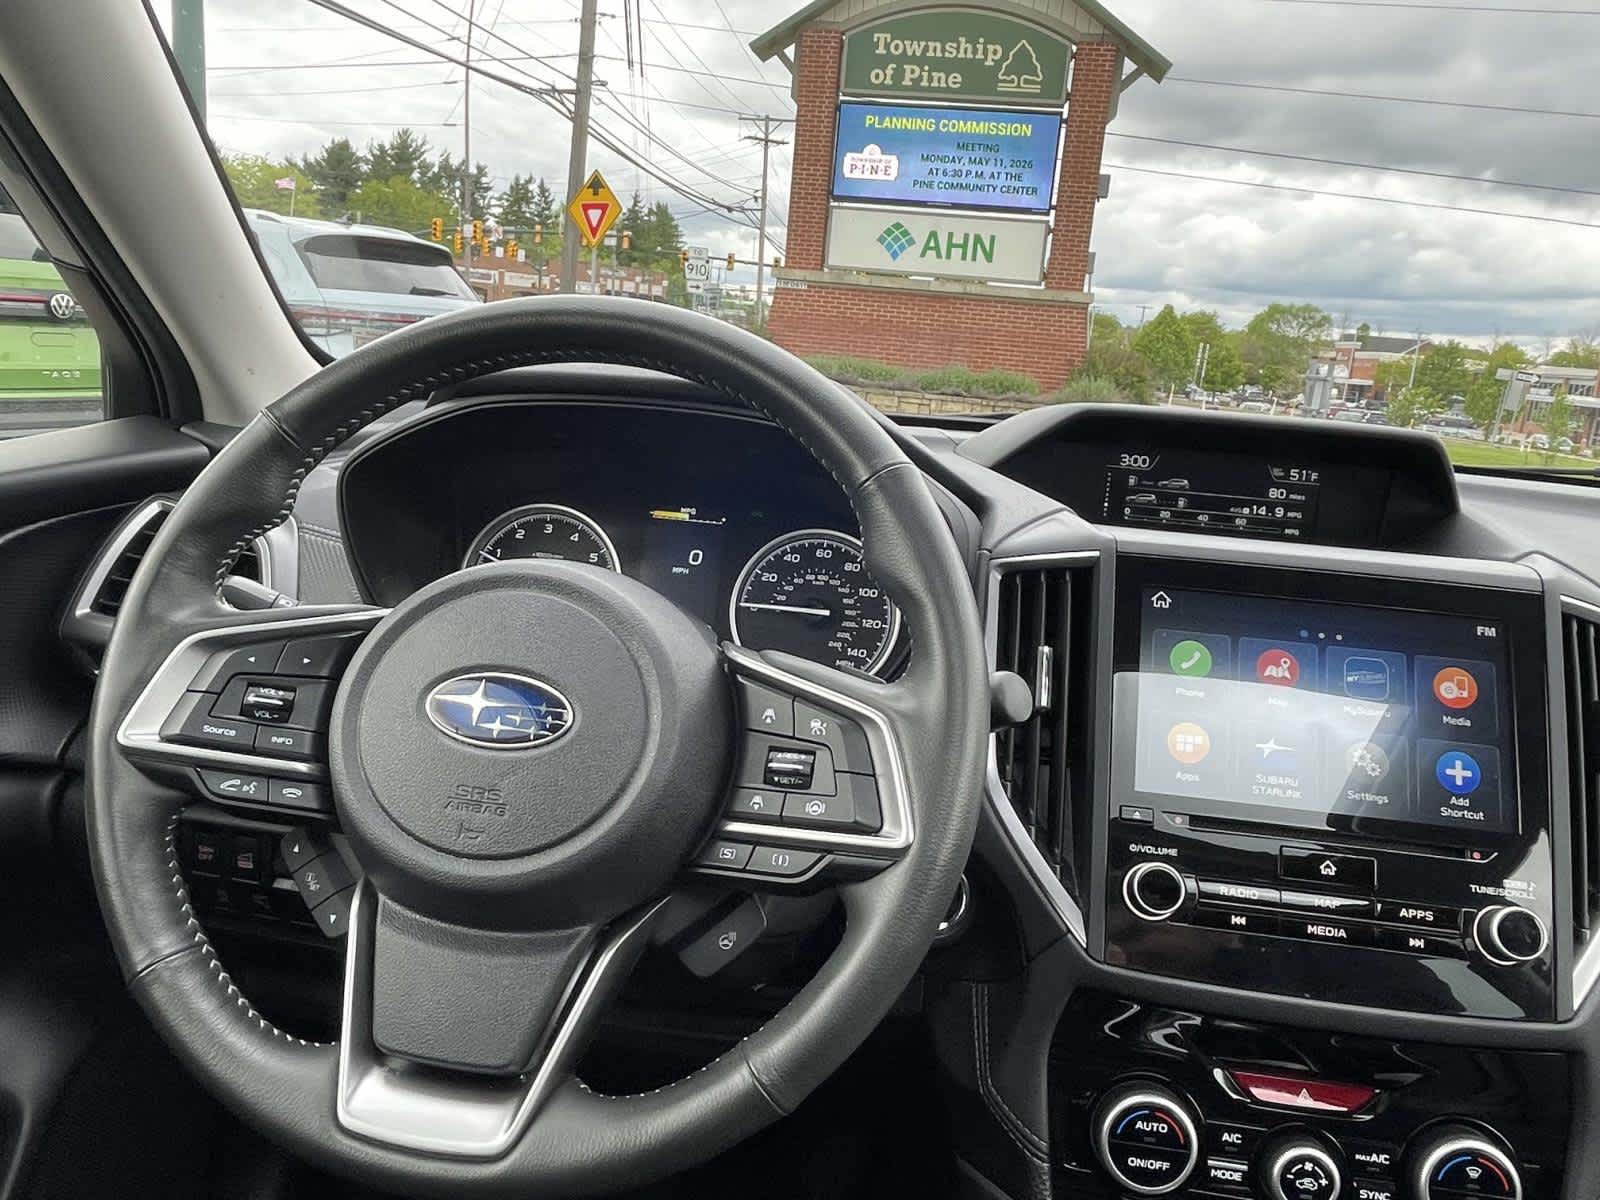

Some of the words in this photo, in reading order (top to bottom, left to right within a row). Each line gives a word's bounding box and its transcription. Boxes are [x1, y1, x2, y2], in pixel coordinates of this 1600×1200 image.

[873, 33, 1003, 66] Township
[870, 64, 896, 85] of
[902, 64, 962, 88] Pine
[865, 115, 936, 131] PLANNING
[939, 120, 1031, 137] COMMISSION
[957, 142, 1000, 153] MEETING
[921, 154, 966, 166] MONDAY,
[968, 157, 989, 166] MAY
[994, 159, 1007, 168] 11,
[1009, 159, 1033, 169] 2026
[928, 168, 939, 176] AT
[942, 168, 963, 178] 6:30
[965, 169, 986, 180] P.M.
[989, 171, 1001, 180] AT
[1004, 172, 1024, 182] THE
[913, 180, 935, 189] PINE
[937, 181, 998, 193] COMMUNITY
[1000, 185, 1038, 196] CENTER
[920, 230, 996, 263] AHN
[686, 263, 707, 277] 910
[1120, 453, 1150, 468] 3:00
[1268, 488, 1287, 499] 80
[1252, 505, 1284, 517] 14.9
[1235, 518, 1247, 526] 60
[515, 529, 525, 539] 2
[544, 524, 553, 533] 3
[570, 533, 579, 541] 4
[496, 549, 501, 557] 1
[589, 553, 598, 562] 5
[689, 549, 703, 565] 0
[784, 554, 800, 563] 40
[815, 549, 832, 558] 60
[844, 562, 860, 572] 80
[761, 572, 778, 582] 20
[859, 588, 878, 597] 100
[862, 619, 882, 629] 120
[1476, 626, 1496, 637] FM
[847, 648, 867, 658] 140
[1442, 715, 1472, 727] Media
[202, 725, 236, 737] Source
[271, 736, 293, 745] INFO
[1175, 771, 1201, 783] Apps
[1255, 774, 1299, 786] SUBARU
[456, 784, 502, 801] SRS
[1252, 785, 1304, 799] STARLINK
[1347, 790, 1389, 805] Settings
[1450, 796, 1470, 807] Add
[444, 800, 506, 817] AIRBAG
[1440, 807, 1485, 820] Shortcut
[1219, 886, 1259, 899] RADIO
[1314, 898, 1341, 909] MAP
[1399, 908, 1434, 921] APPS
[1307, 924, 1347, 938] MEDIA
[1135, 1120, 1169, 1134] AUTO
[1222, 1132, 1242, 1144] A/C
[1128, 1157, 1171, 1171] ON/OFF
[1370, 1153, 1390, 1165] A/C
[1211, 1168, 1243, 1182] MODE
[1359, 1189, 1391, 1200] SYNC
